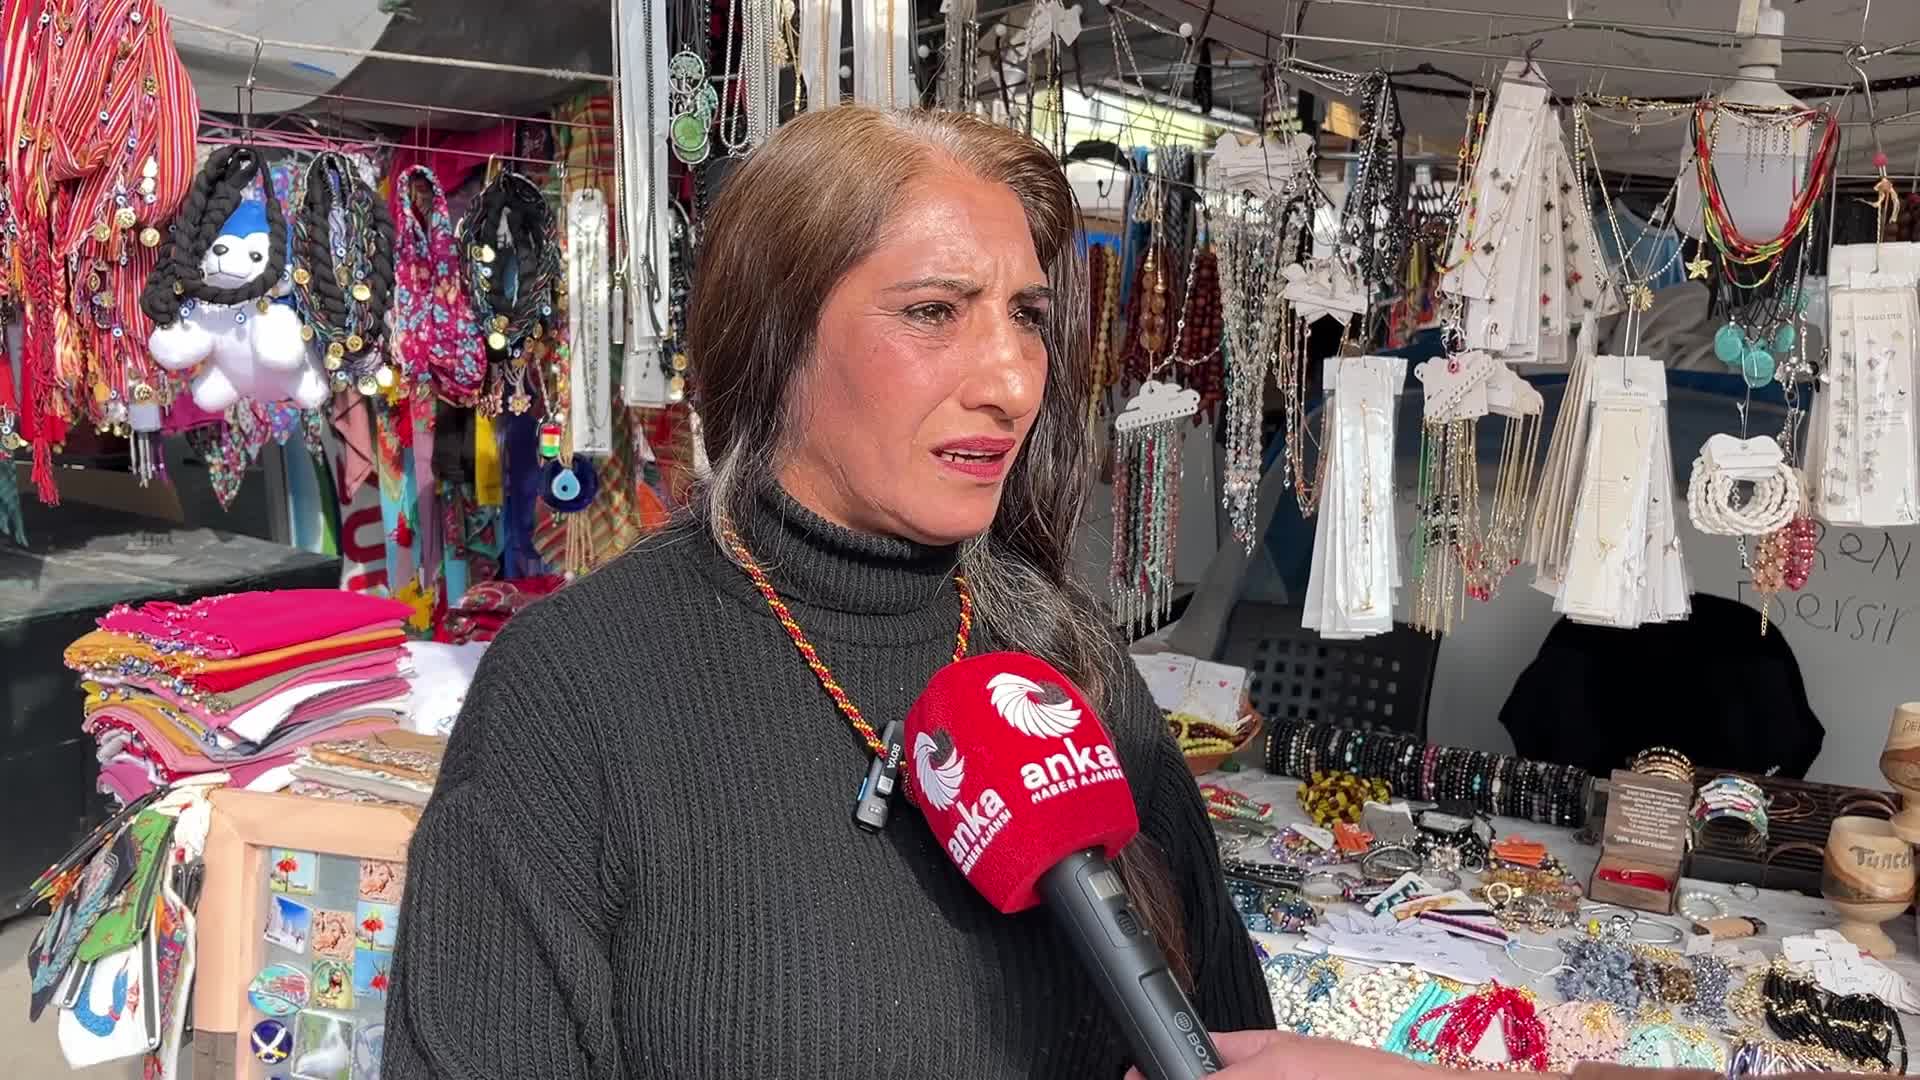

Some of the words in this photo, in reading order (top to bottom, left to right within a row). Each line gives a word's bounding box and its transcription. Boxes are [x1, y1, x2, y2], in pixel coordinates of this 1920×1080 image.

[887, 743, 901, 769] BOYA
[1020, 737, 1119, 790] anka
[1031, 778, 1078, 804] HABER
[1080, 768, 1124, 786] AJANSI
[947, 788, 1006, 865] anka
